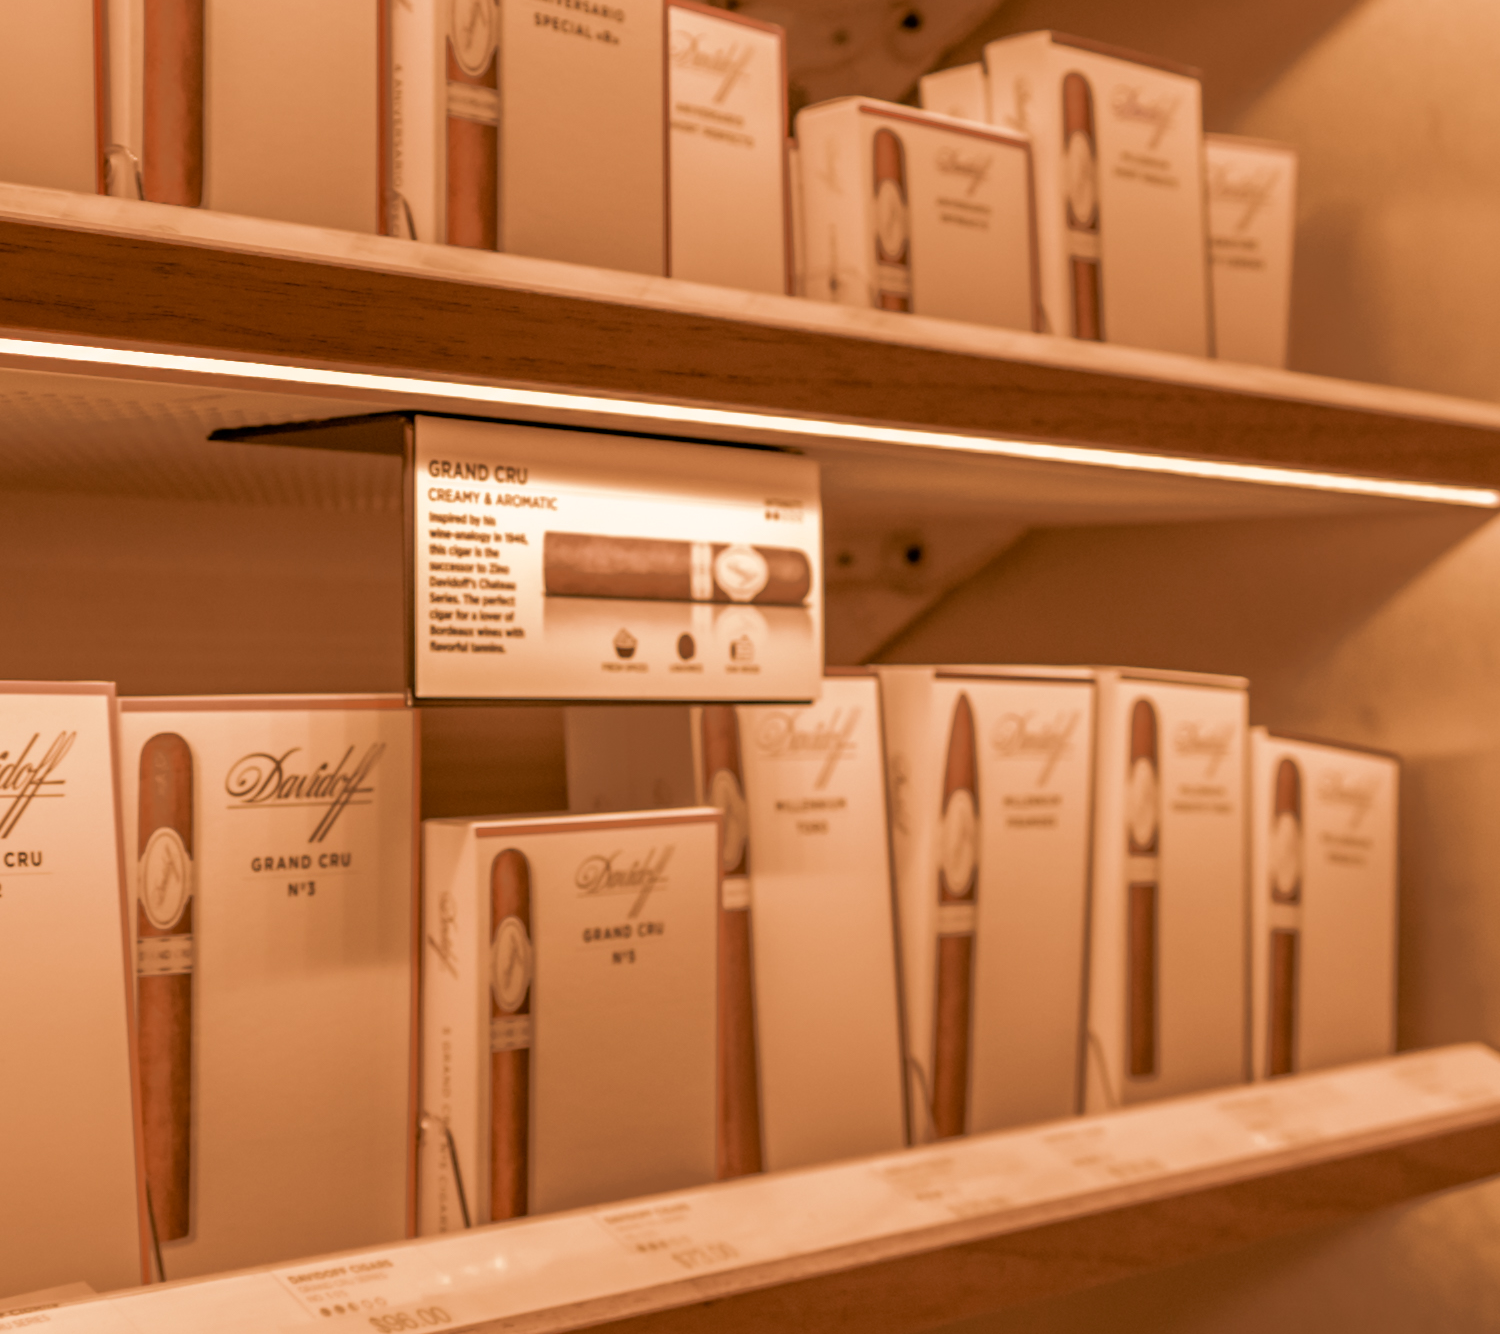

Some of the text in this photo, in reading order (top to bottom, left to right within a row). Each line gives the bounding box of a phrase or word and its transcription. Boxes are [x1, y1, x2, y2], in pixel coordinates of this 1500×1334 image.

[533, 12, 592, 40] SPECIAL
[428, 460, 528, 485] GRAND CRU
[428, 487, 558, 511] CREAMY & AROMATIC
[225, 742, 386, 843] Davidoff
[4, 851, 42, 867] CRU
[251, 853, 351, 872] GRAND CRU
[575, 844, 676, 919] Davidoff
[583, 922, 664, 943] GRAND CRU
